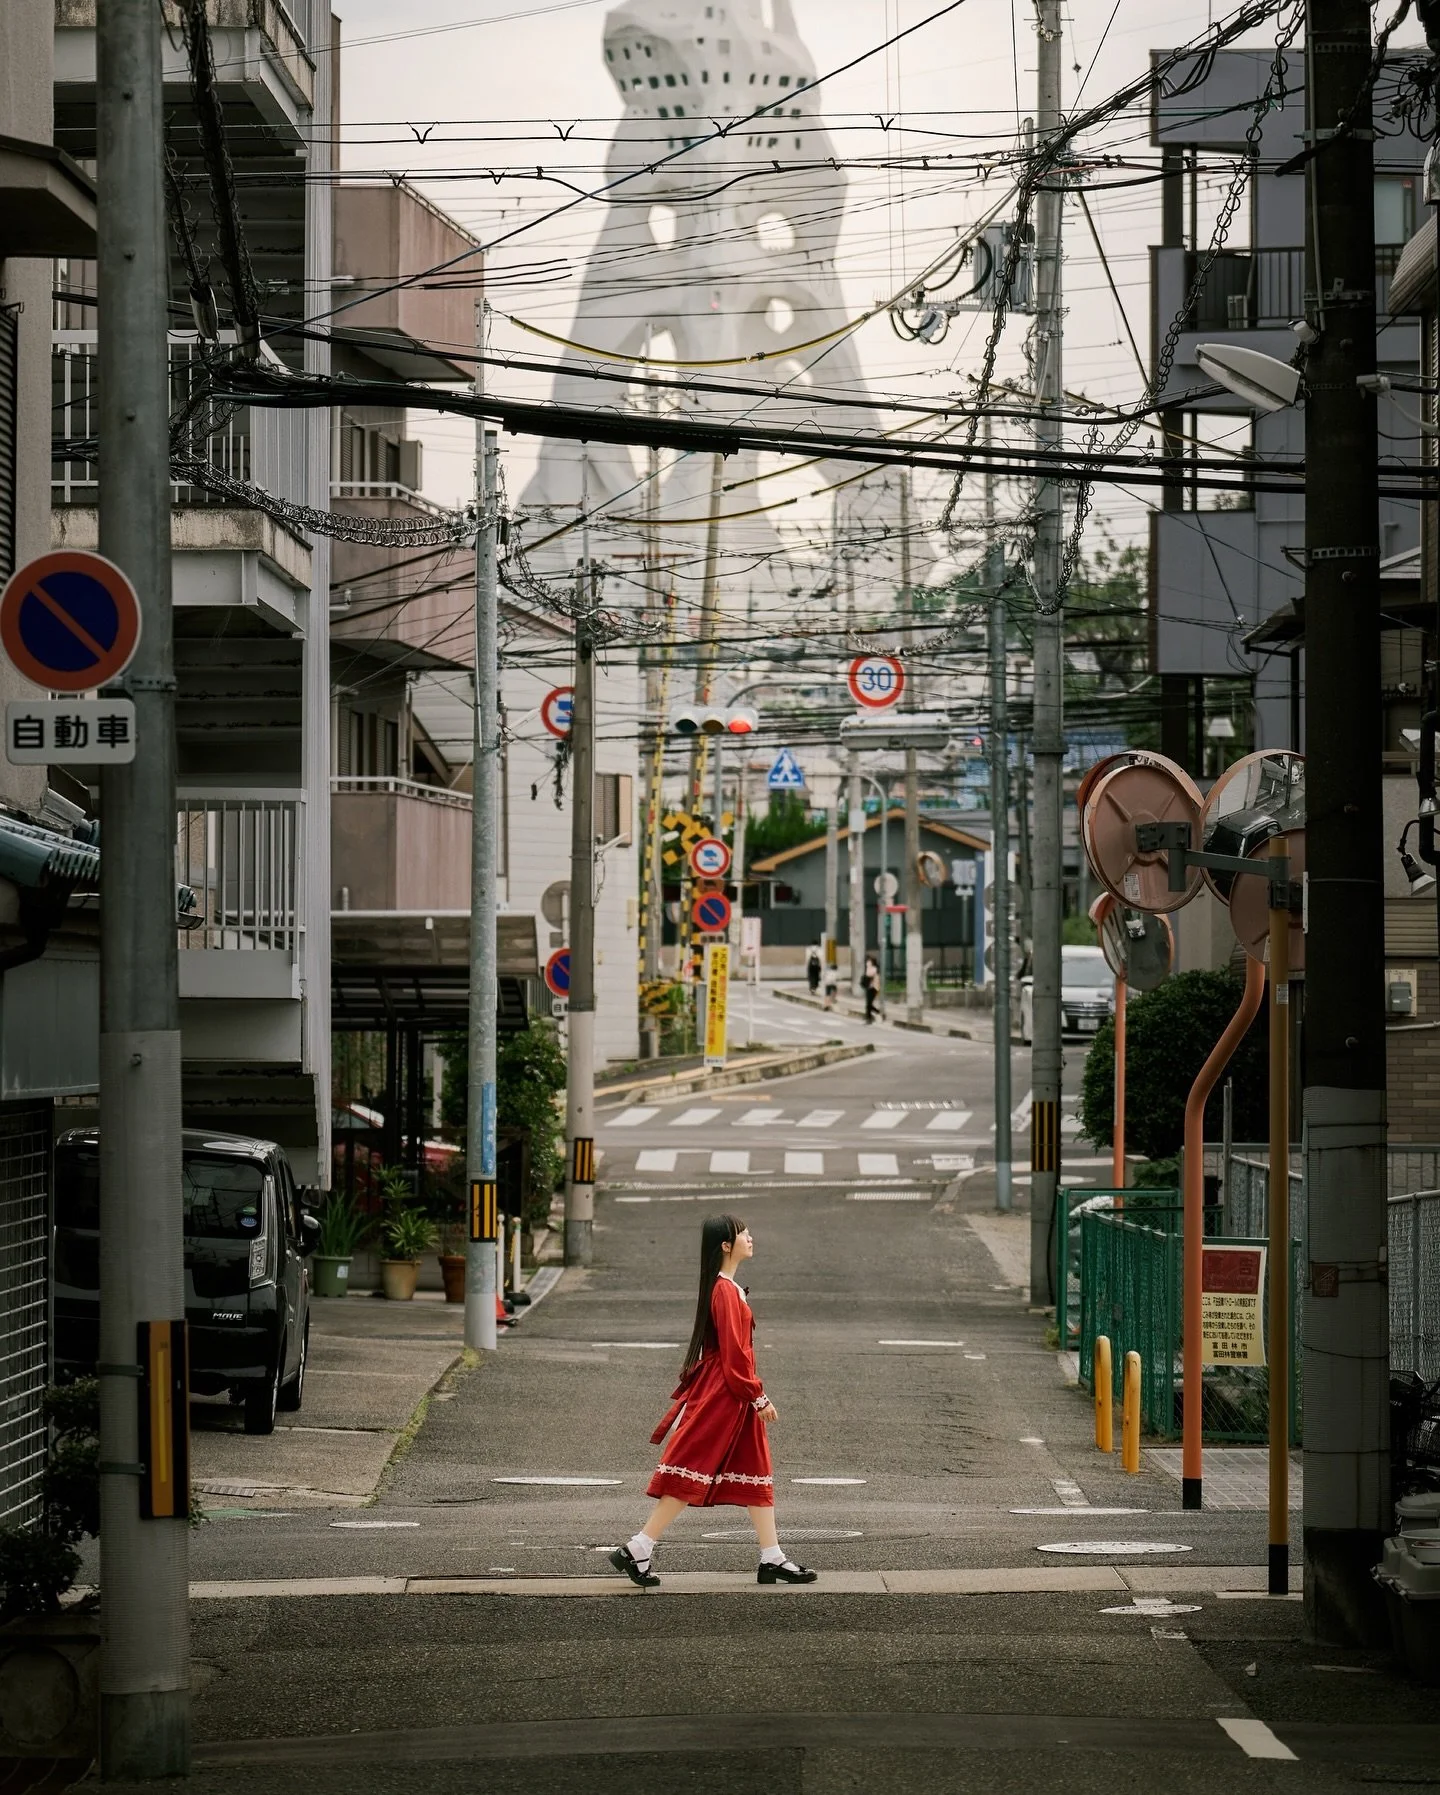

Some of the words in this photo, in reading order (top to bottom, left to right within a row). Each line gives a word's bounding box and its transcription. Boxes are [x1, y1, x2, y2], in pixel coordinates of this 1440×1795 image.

[862, 667, 891, 691] 30
[13, 714, 130, 749] 自動車
[212, 1313, 243, 1321] MOVE
